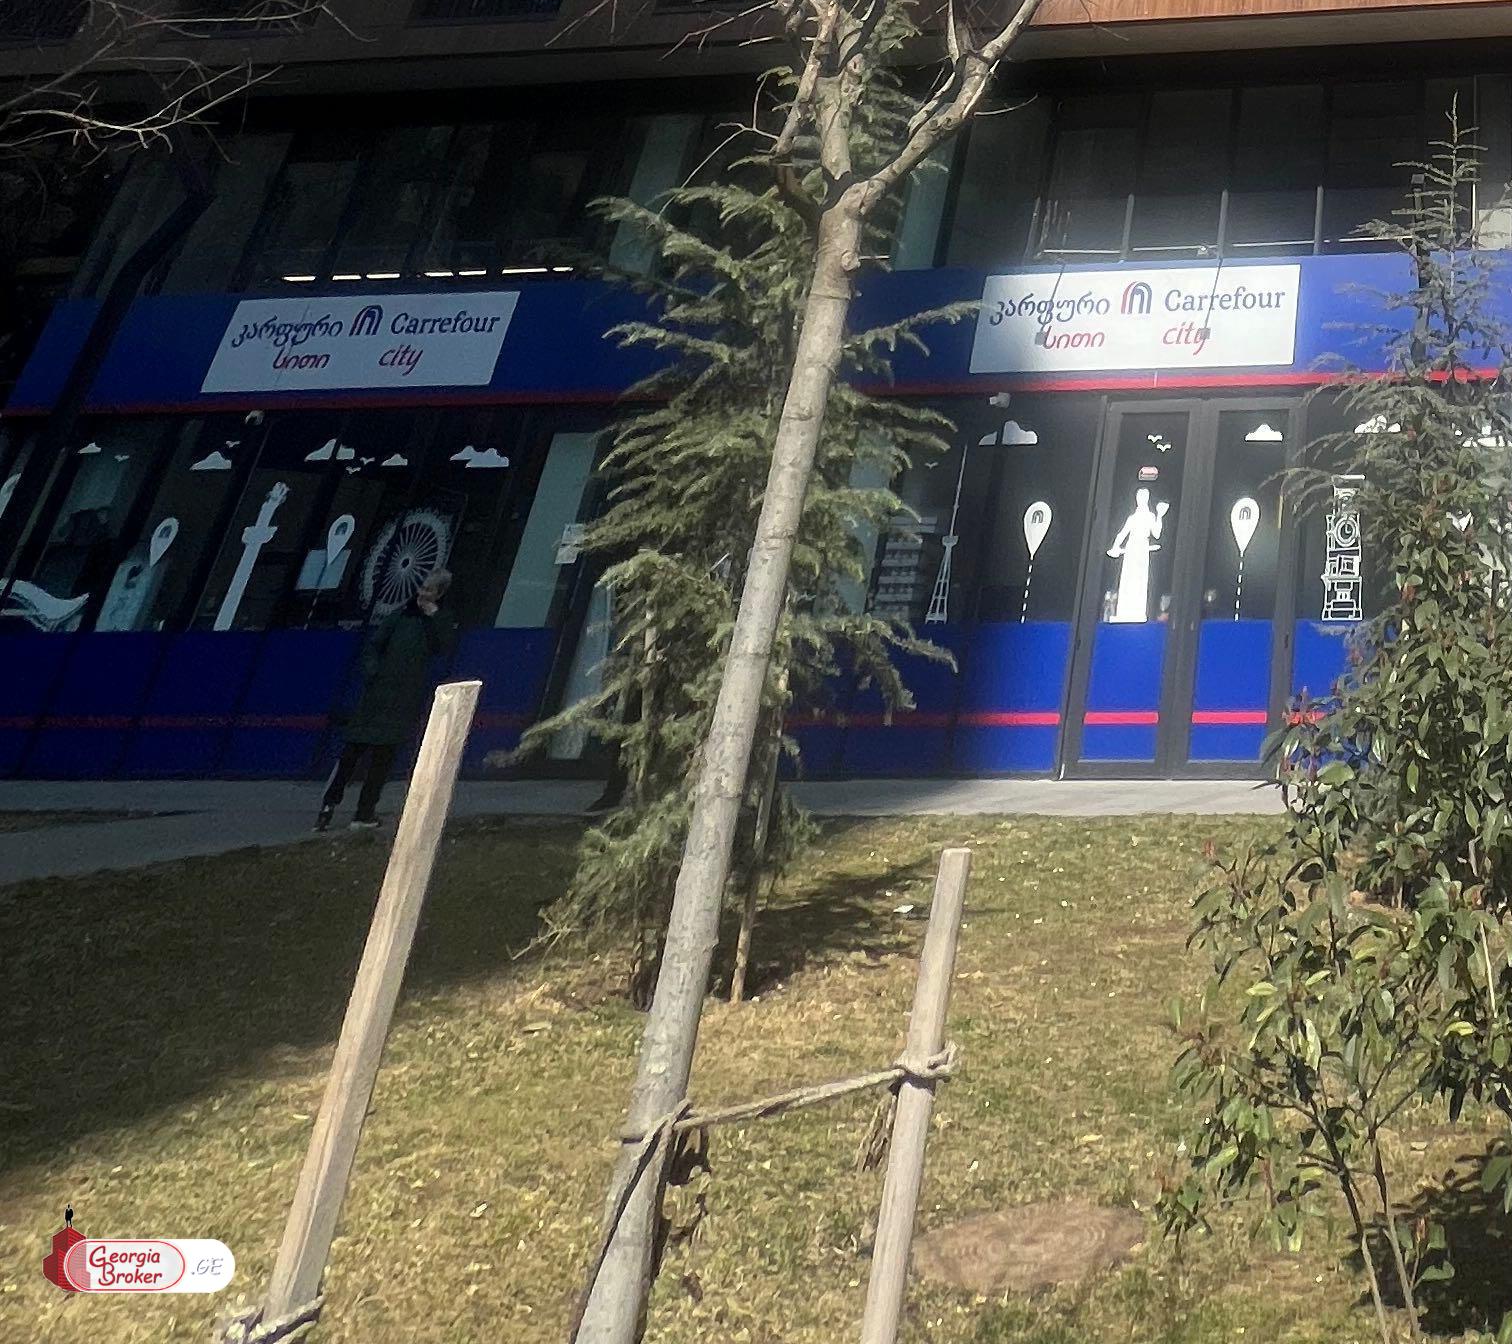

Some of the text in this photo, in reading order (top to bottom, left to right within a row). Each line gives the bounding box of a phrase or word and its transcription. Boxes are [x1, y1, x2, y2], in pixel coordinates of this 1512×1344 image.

[989, 286, 1286, 327] კარფური Carrefour
[231, 310, 502, 348] კარფური Carrefour
[1042, 320, 1208, 356] სითი city
[272, 344, 424, 377] სითი city
